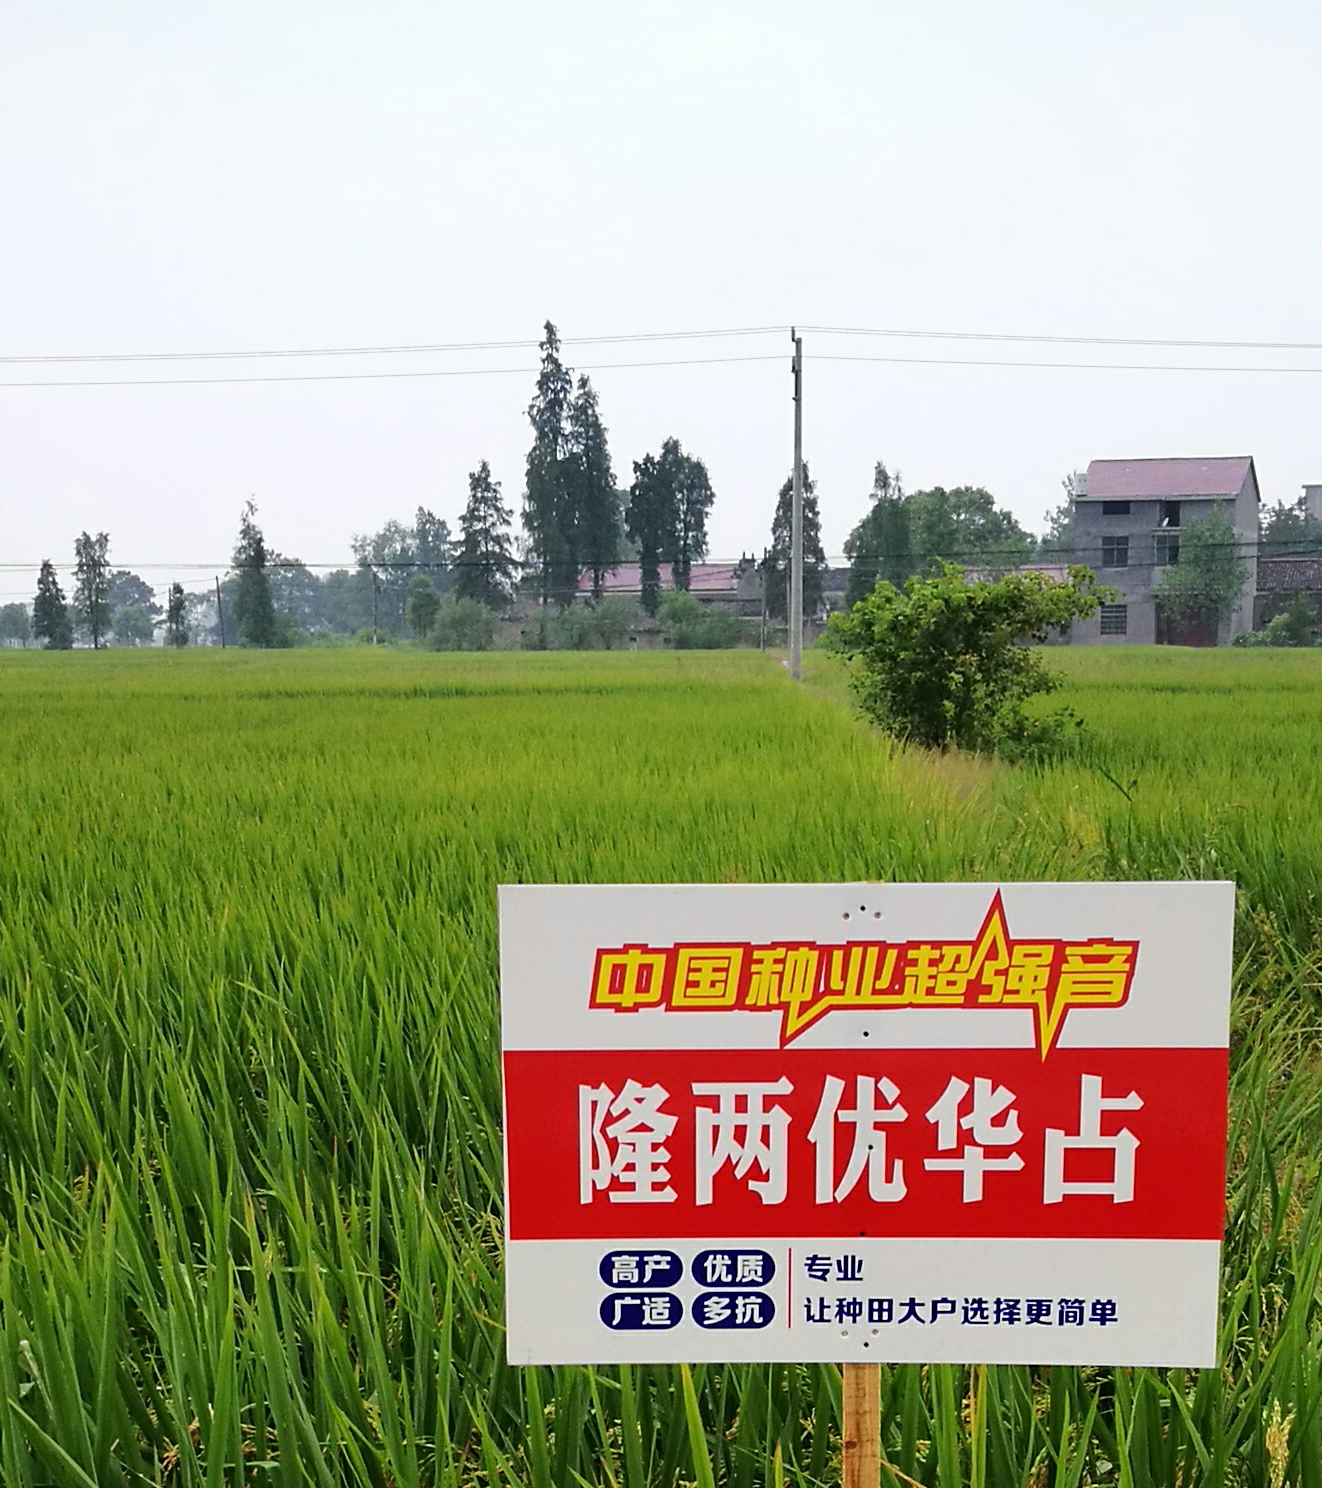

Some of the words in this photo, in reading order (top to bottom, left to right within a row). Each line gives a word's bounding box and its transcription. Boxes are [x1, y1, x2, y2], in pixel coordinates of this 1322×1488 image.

[579, 1074, 1144, 1205] 隆两优华占
[610, 1254, 672, 1284] 高产
[703, 1254, 765, 1284] 优质
[804, 1254, 864, 1282] 专业
[611, 1296, 673, 1327] 广适
[703, 1296, 765, 1327] 多抗
[804, 1296, 1119, 1327] 让种田大户选择更简单
